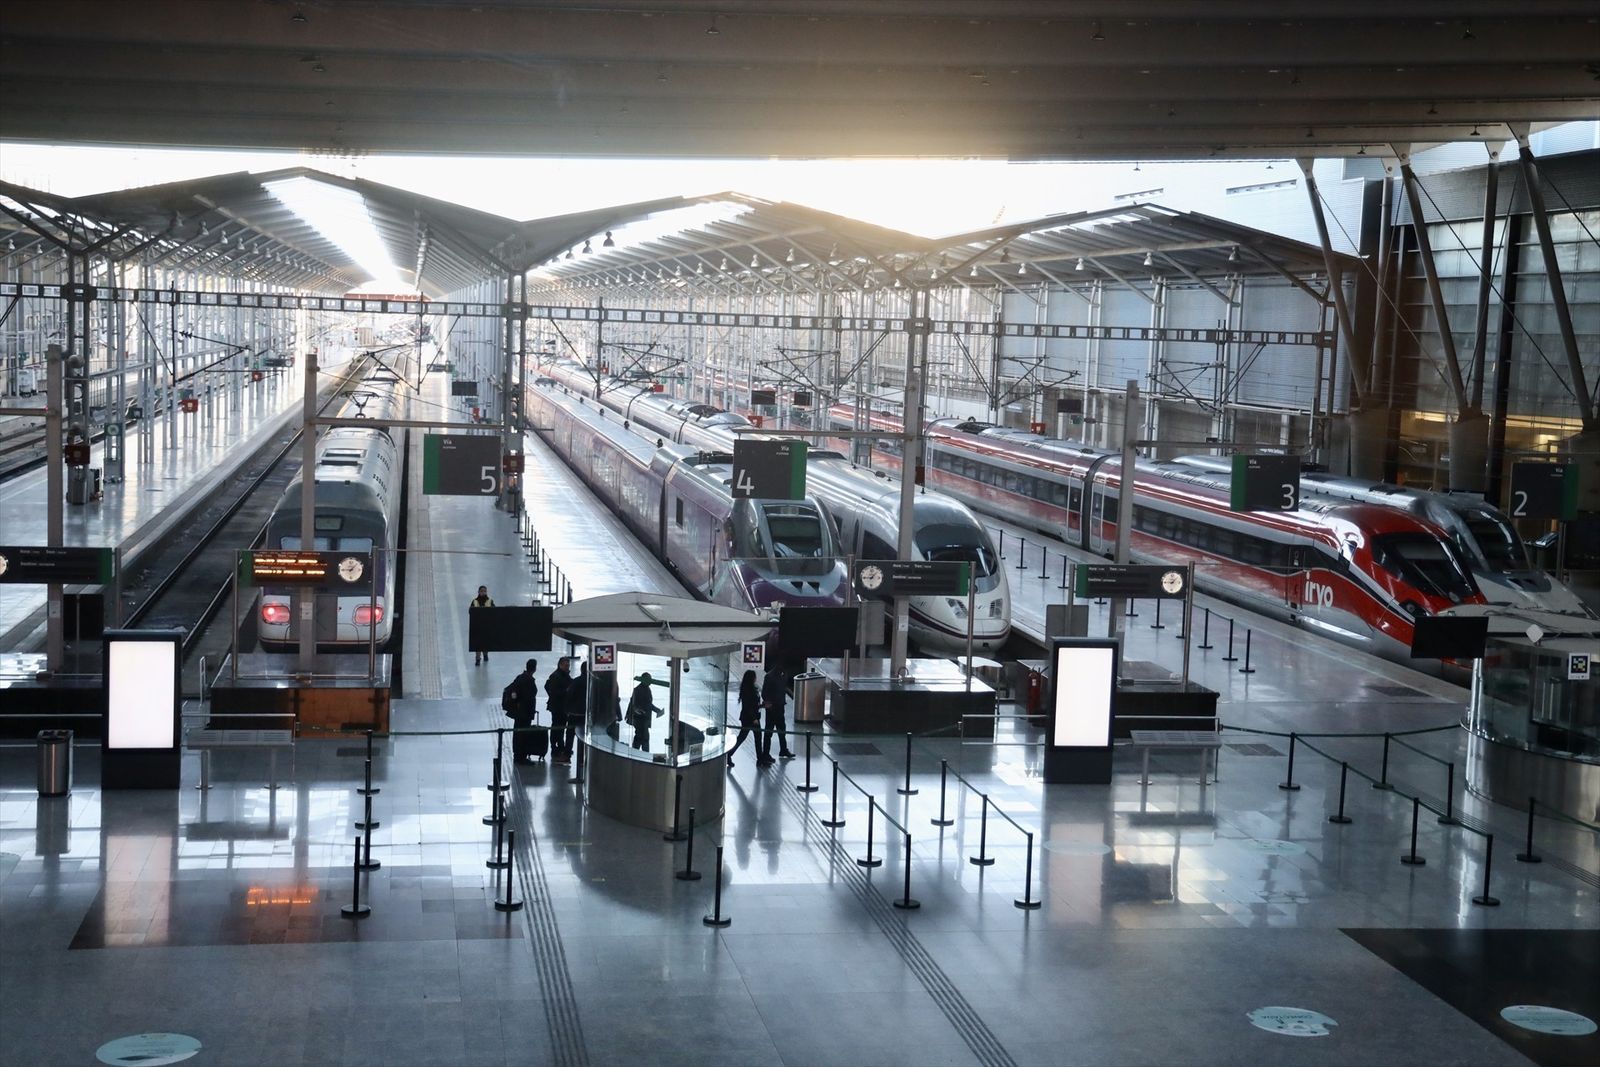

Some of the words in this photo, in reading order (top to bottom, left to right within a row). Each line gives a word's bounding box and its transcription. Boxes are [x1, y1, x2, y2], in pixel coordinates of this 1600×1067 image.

[481, 465, 496, 493] 5
[736, 469, 755, 496] 4
[1281, 483, 1295, 510] 3
[1513, 490, 1528, 516] 2
[1304, 571, 1334, 615] iryo
